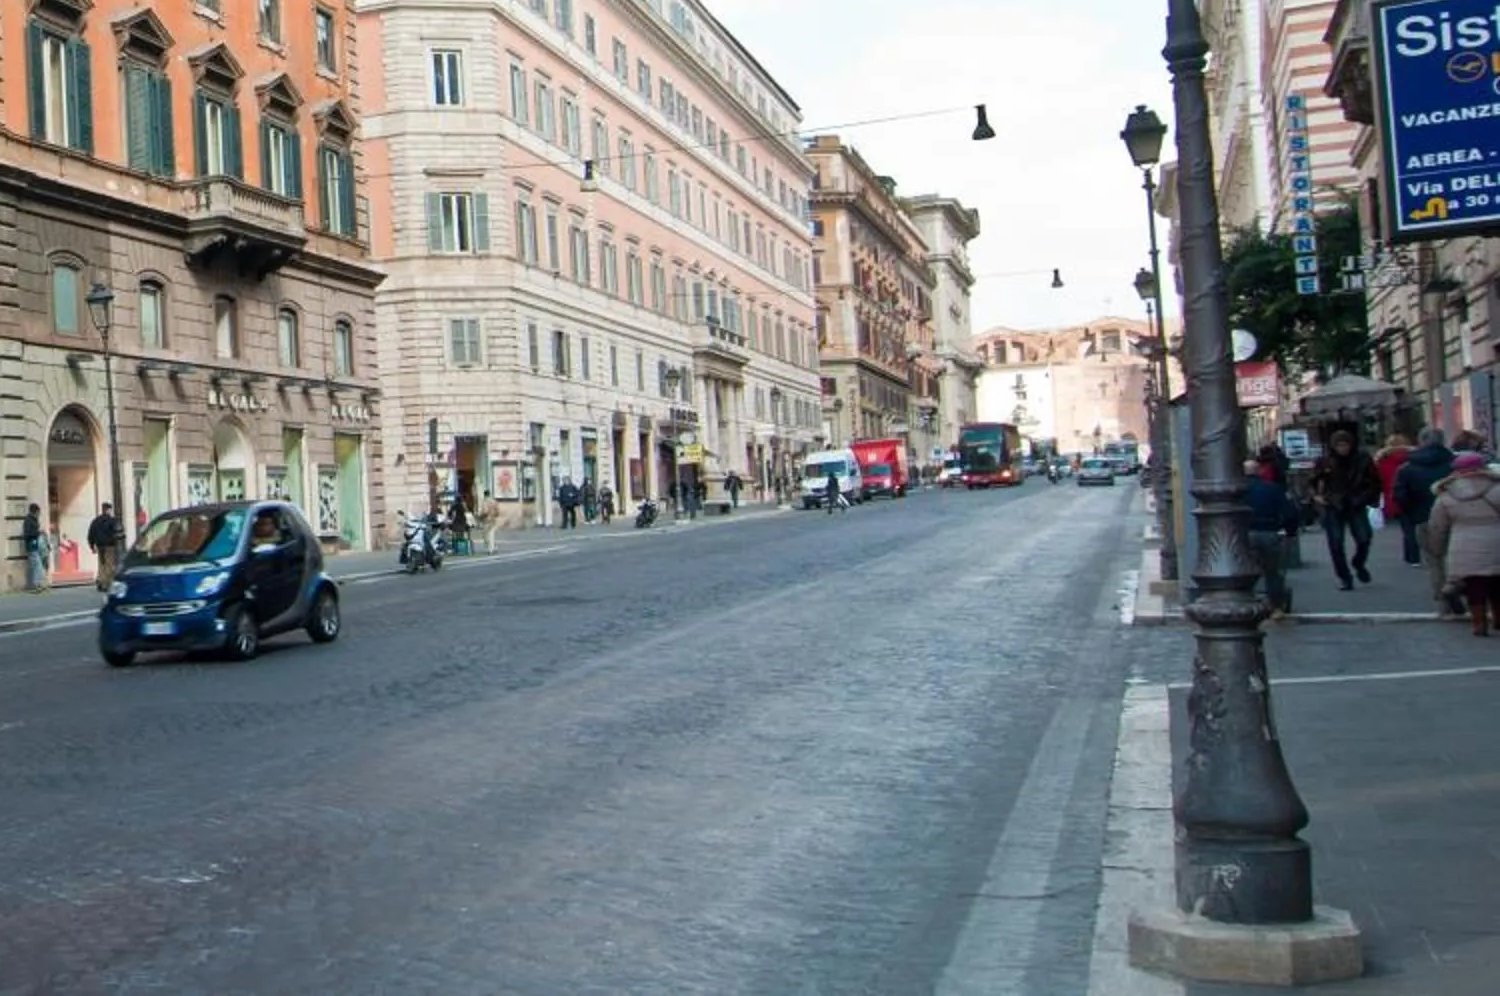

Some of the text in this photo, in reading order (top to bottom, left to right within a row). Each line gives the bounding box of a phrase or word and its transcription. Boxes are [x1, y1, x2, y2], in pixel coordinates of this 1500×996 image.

[1401, 103, 1500, 128] VACANZE
[1406, 148, 1484, 169] AEREA
[1288, 95, 1316, 292] RISTORANTE
[1407, 173, 1500, 196] Via DEL
[1465, 194, 1489, 207] 30
